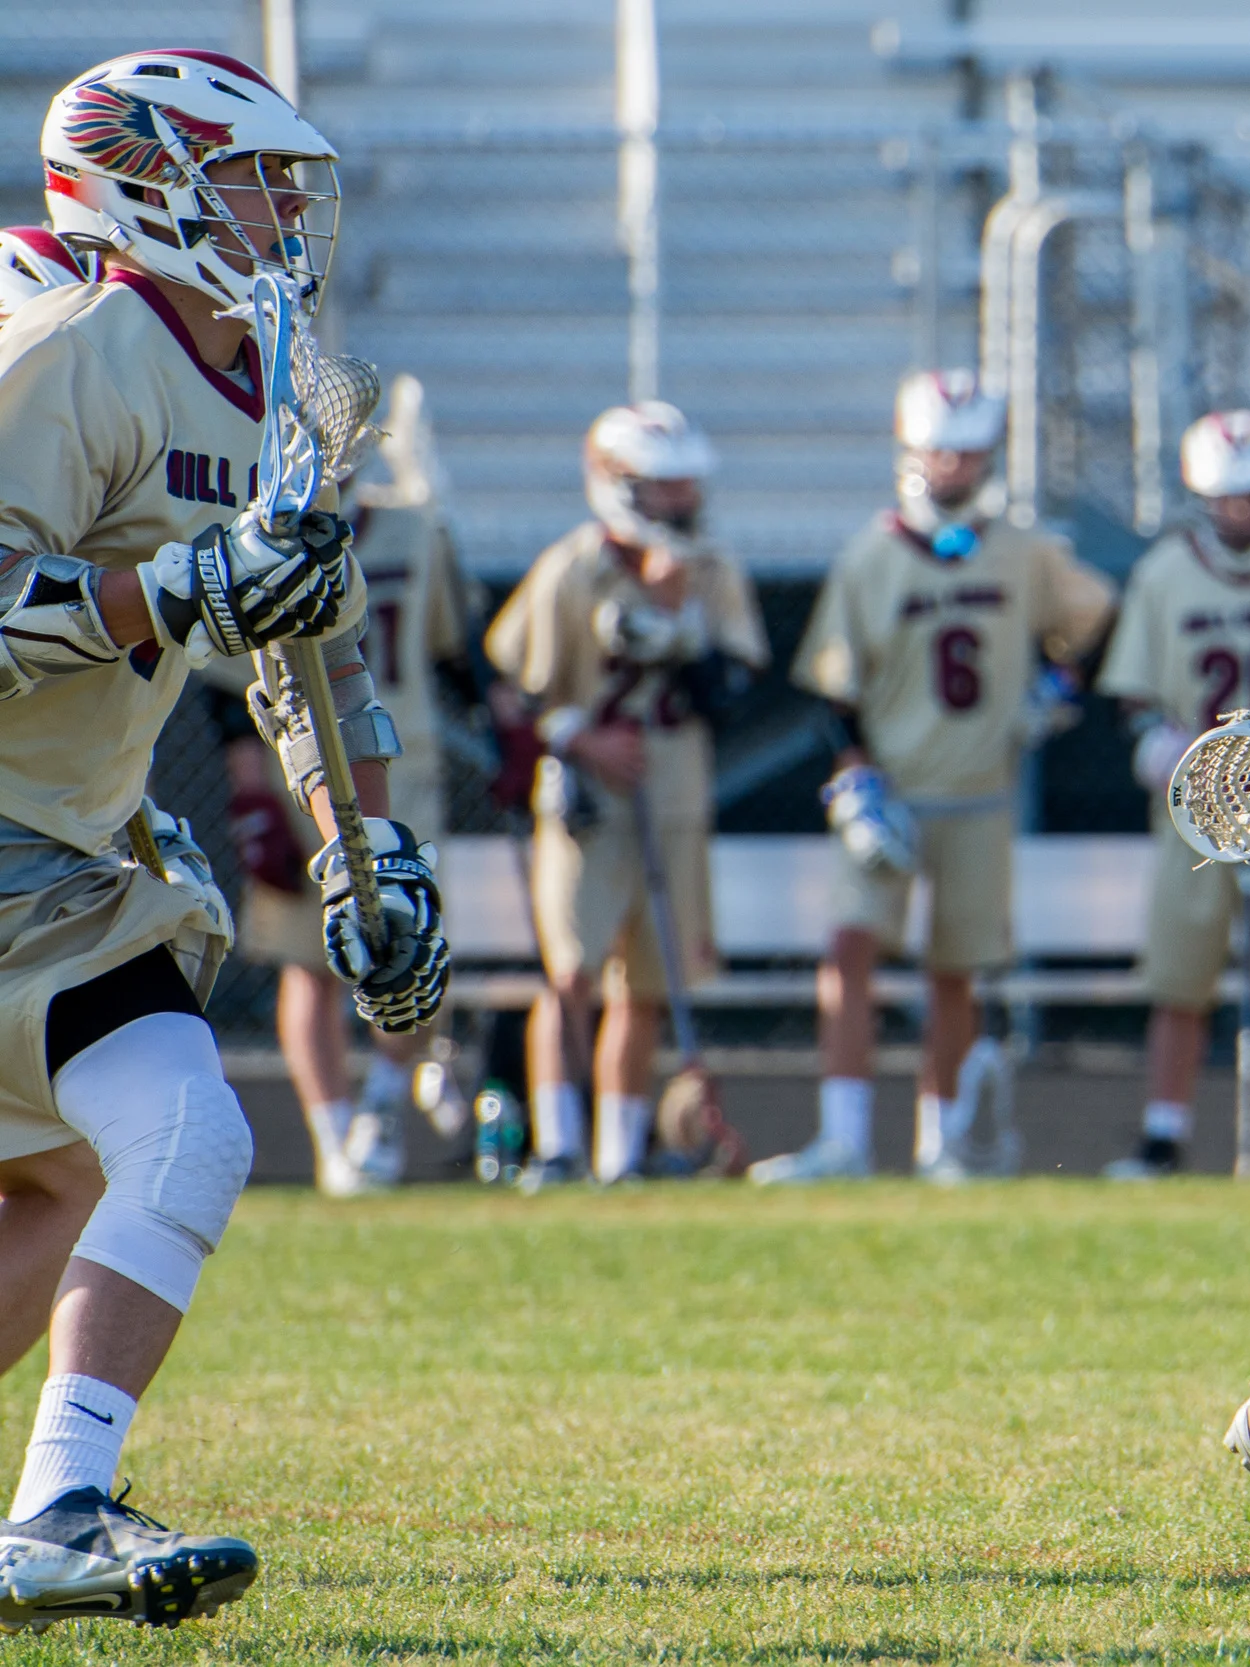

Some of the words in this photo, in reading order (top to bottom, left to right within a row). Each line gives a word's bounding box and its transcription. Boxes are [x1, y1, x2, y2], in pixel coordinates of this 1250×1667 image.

[198, 547, 249, 655] WARRIOR
[936, 627, 982, 711] 6
[1173, 785, 1182, 807] STX
[154, 834, 185, 849] TX
